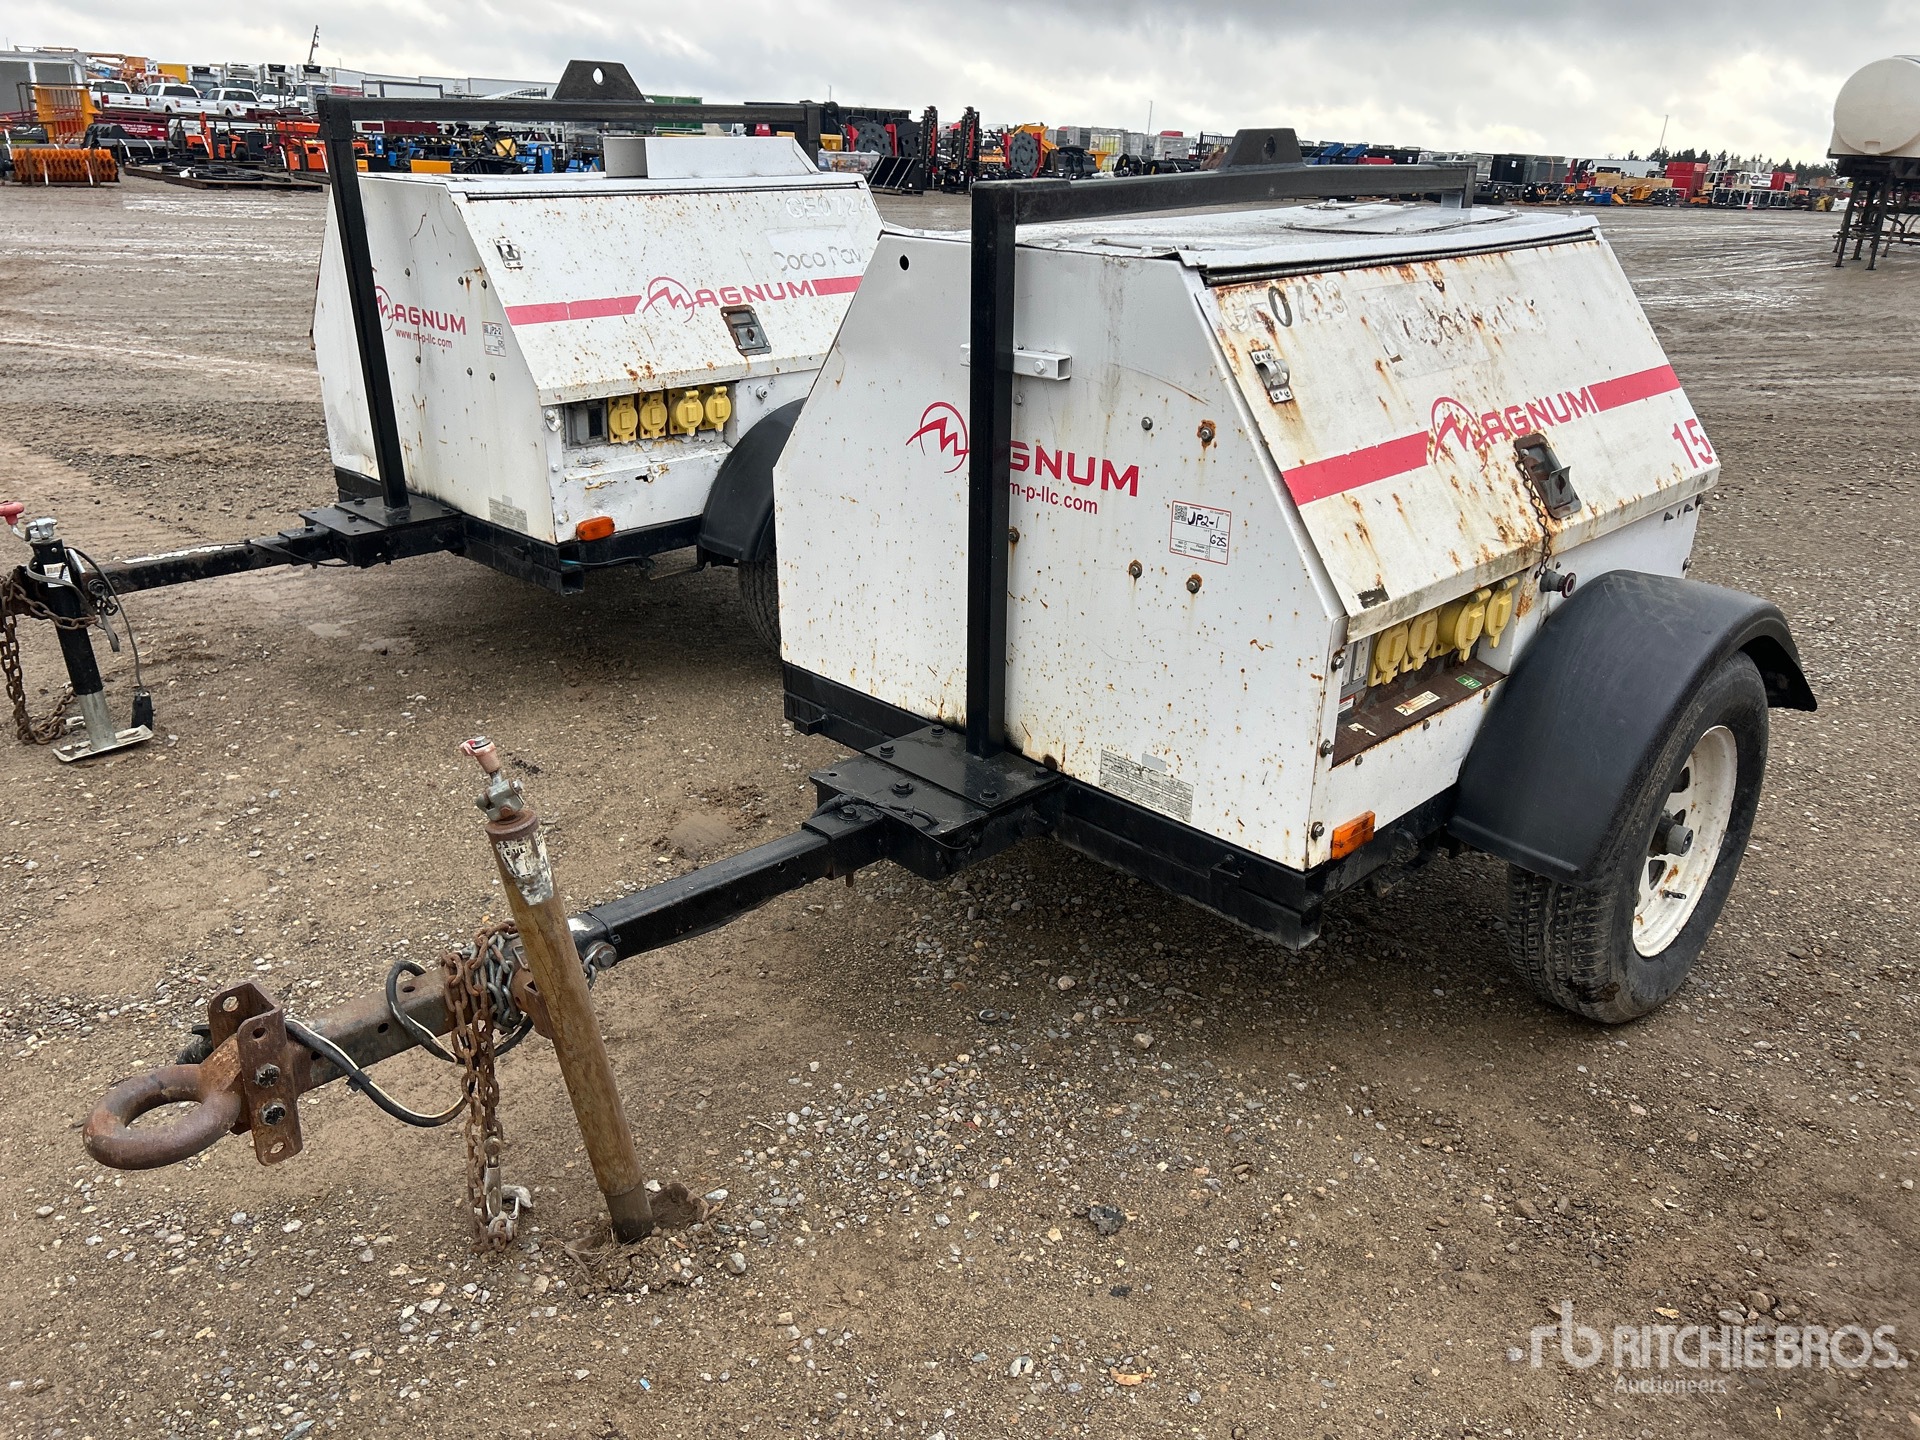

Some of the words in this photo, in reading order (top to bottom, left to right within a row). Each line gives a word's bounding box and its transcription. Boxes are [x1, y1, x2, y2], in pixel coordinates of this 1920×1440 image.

[375, 286, 467, 335] MAGNUM
[642, 276, 814, 323] MAGNUM
[395, 329, 453, 349] www.m-p-llc.com
[906, 401, 1140, 497] MGNUM
[1431, 386, 1598, 472] MAGNUM
[1672, 418, 1713, 469] 15
[1009, 482, 1098, 515] m-p-llc.com
